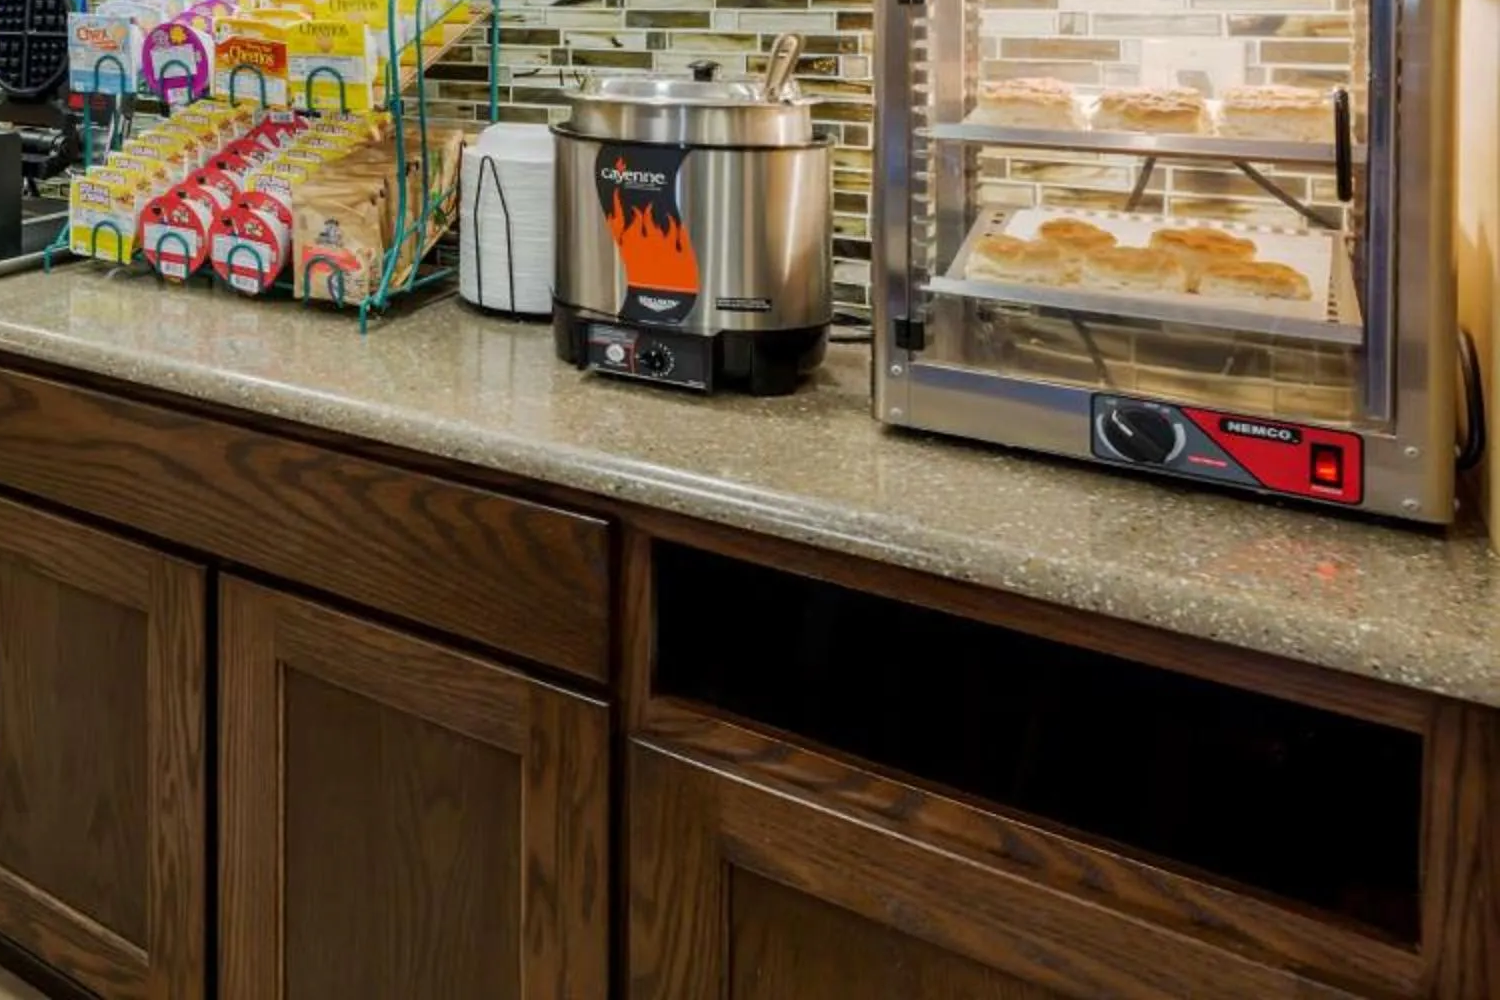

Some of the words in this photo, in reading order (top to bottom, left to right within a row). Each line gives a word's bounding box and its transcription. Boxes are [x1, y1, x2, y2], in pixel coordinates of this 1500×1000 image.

[299, 21, 348, 37] Cheerios
[229, 46, 276, 67] Cheerios
[601, 167, 666, 185] cayenne
[1227, 420, 1292, 440] NEMCO
